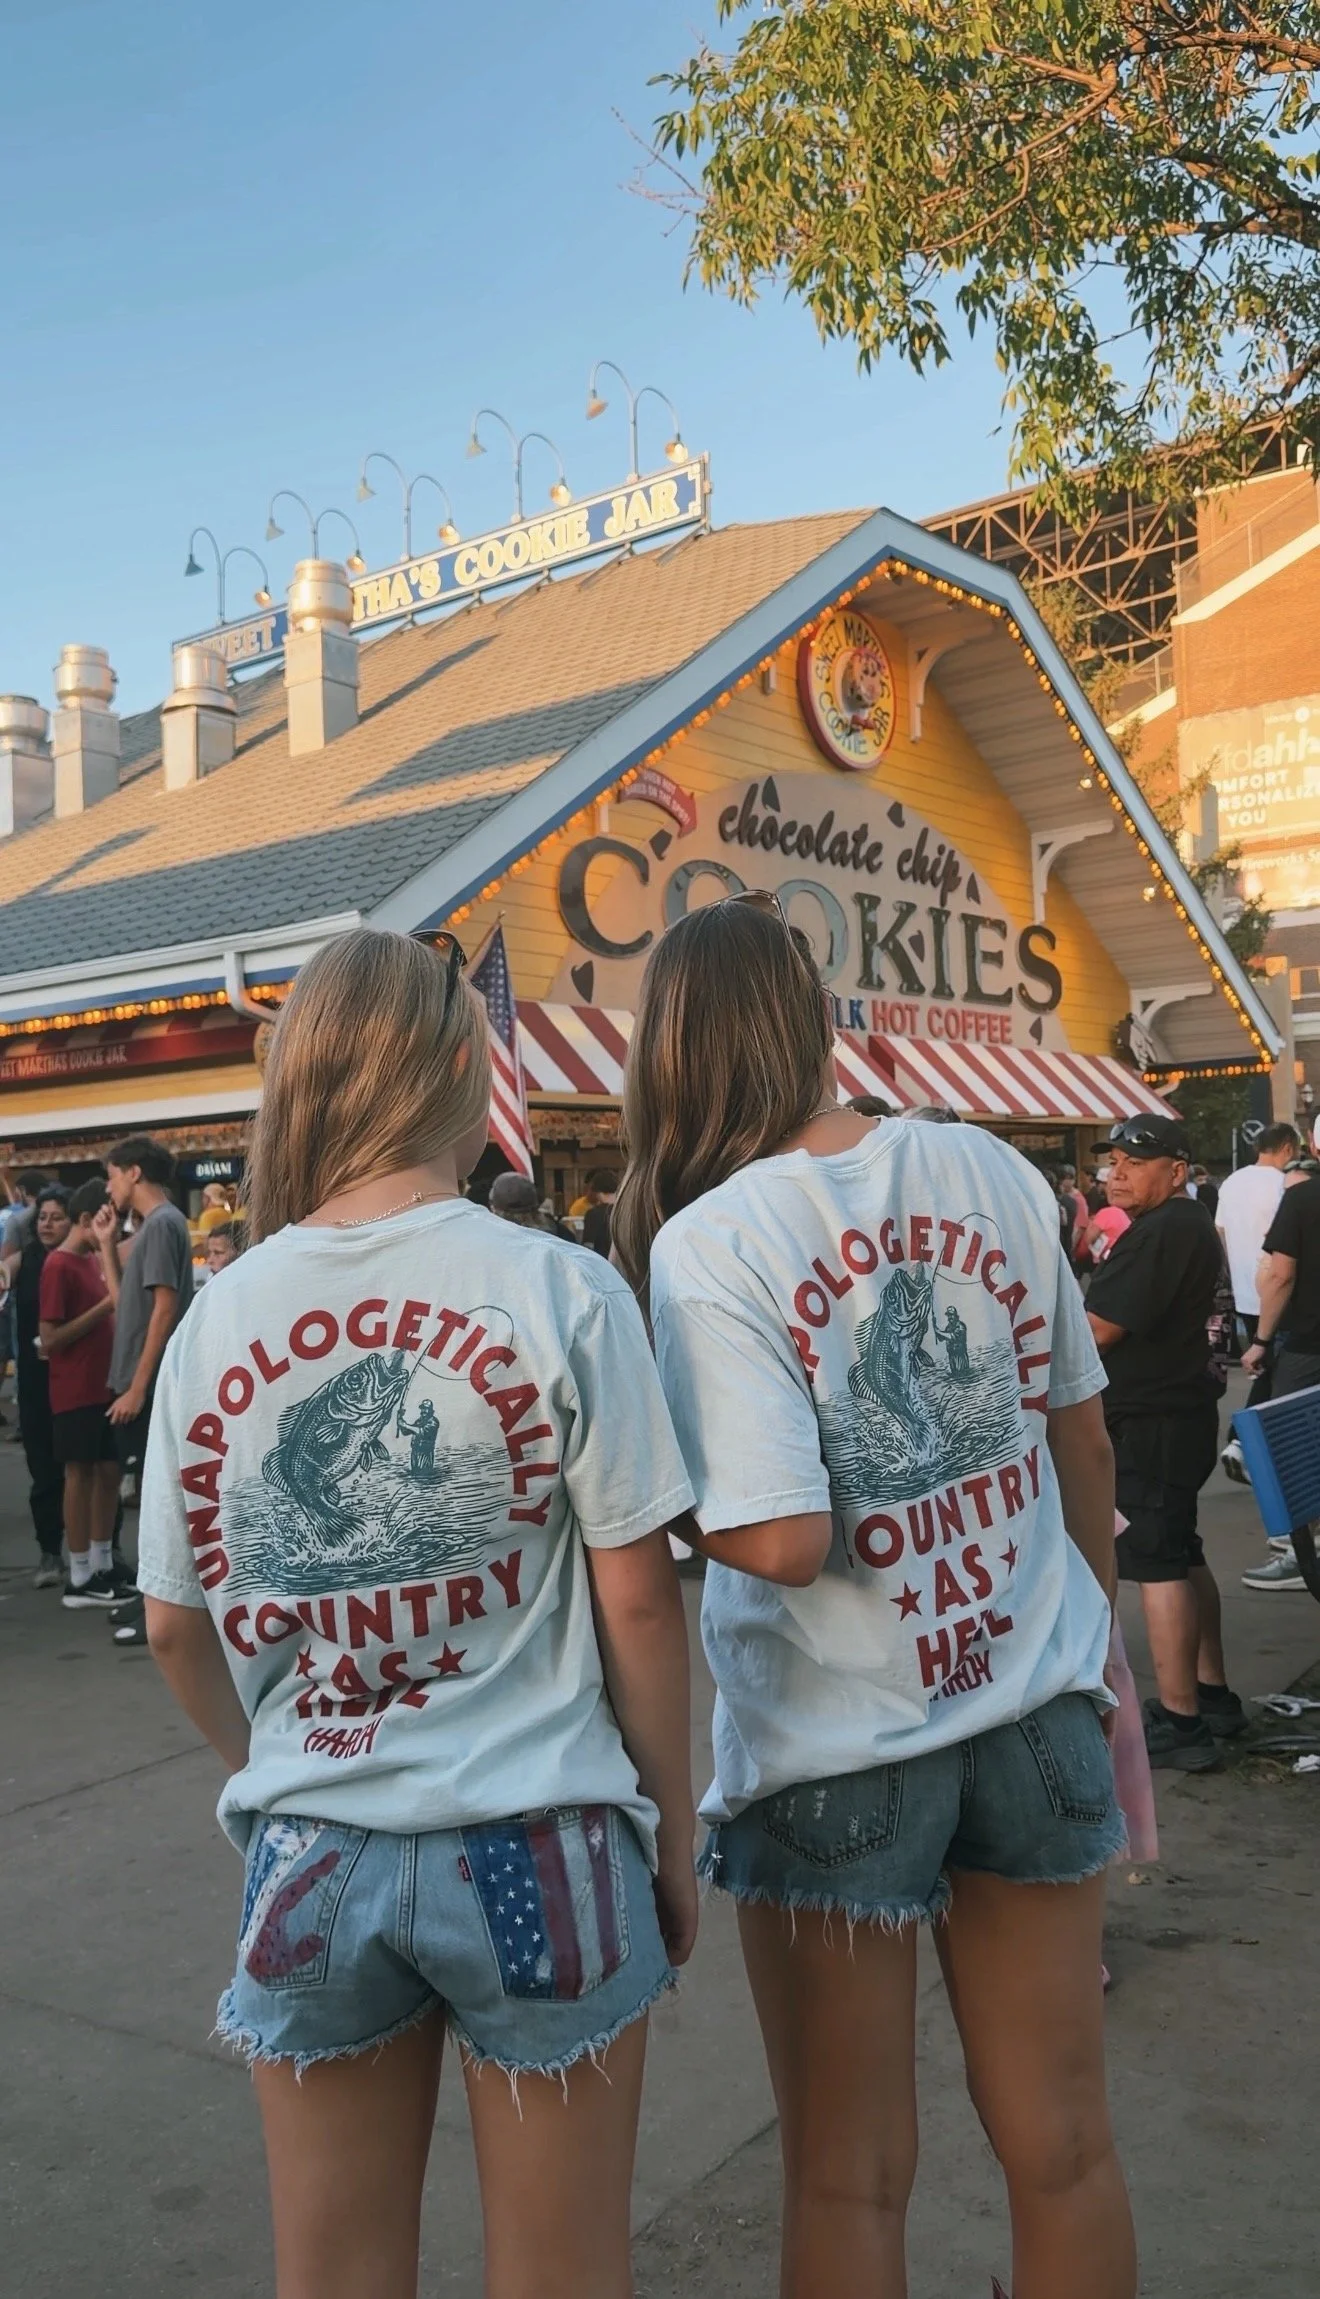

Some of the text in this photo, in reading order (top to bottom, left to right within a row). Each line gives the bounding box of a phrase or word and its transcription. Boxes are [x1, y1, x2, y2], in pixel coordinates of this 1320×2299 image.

[196, 478, 681, 662] WEET THA'S COOKIE JAR
[1211, 768, 1289, 794] MFORT
[1226, 807, 1267, 829] YOU
[718, 782, 963, 907] chocolate chip
[69, 1047, 104, 1070] COOKIE
[871, 999, 920, 1036] HOT
[927, 1005, 1013, 1045] COFFEE
[195, 1161, 232, 1178] DASANI
[787, 1214, 1052, 1417] POLOGETICALLY
[180, 1297, 560, 1592] UNAPOLOGETICALLY
[841, 1444, 1041, 1570] OUNTRY
[223, 1548, 523, 1658] COUNTRY
[935, 1543, 993, 1617] AS
[331, 1650, 411, 1697] AS
